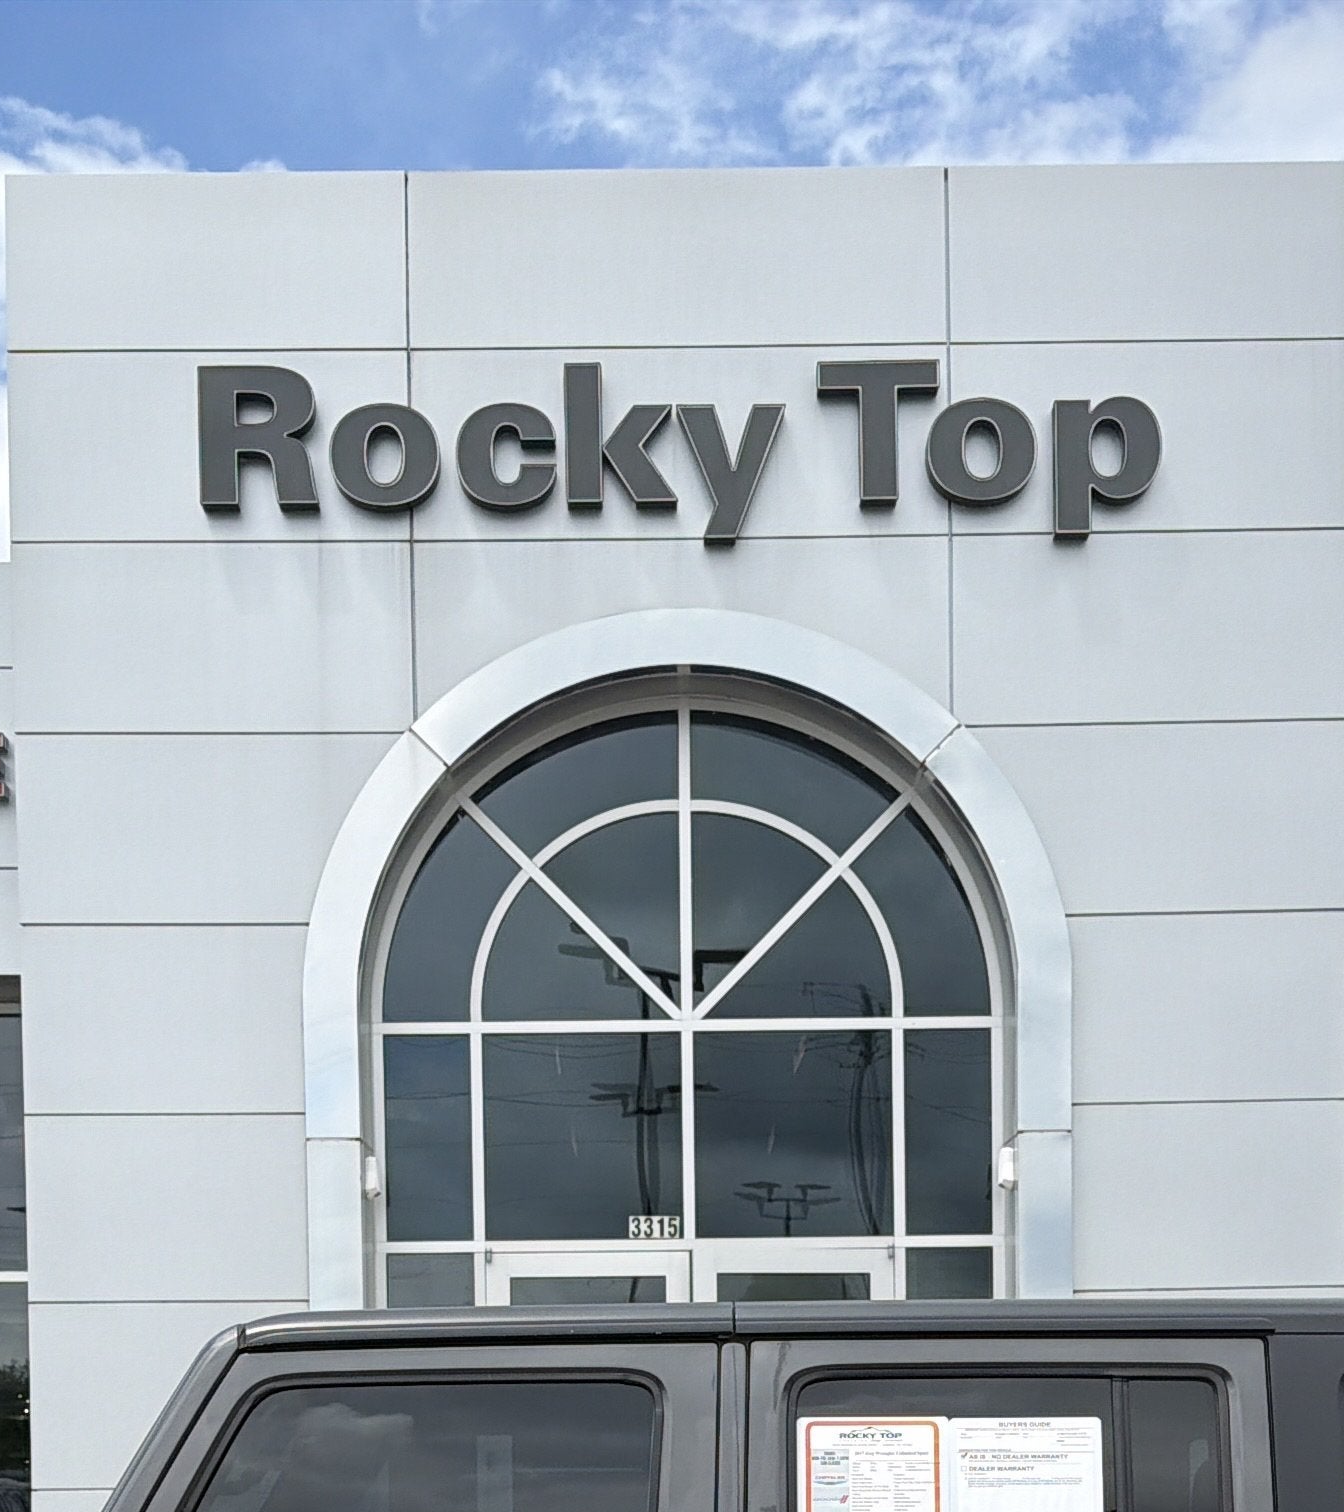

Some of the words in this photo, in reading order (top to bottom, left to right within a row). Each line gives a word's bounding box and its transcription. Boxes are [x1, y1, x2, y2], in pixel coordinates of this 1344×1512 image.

[196, 361, 787, 547] Rocky
[815, 358, 1162, 540] Top
[631, 1217, 678, 1238] 3315
